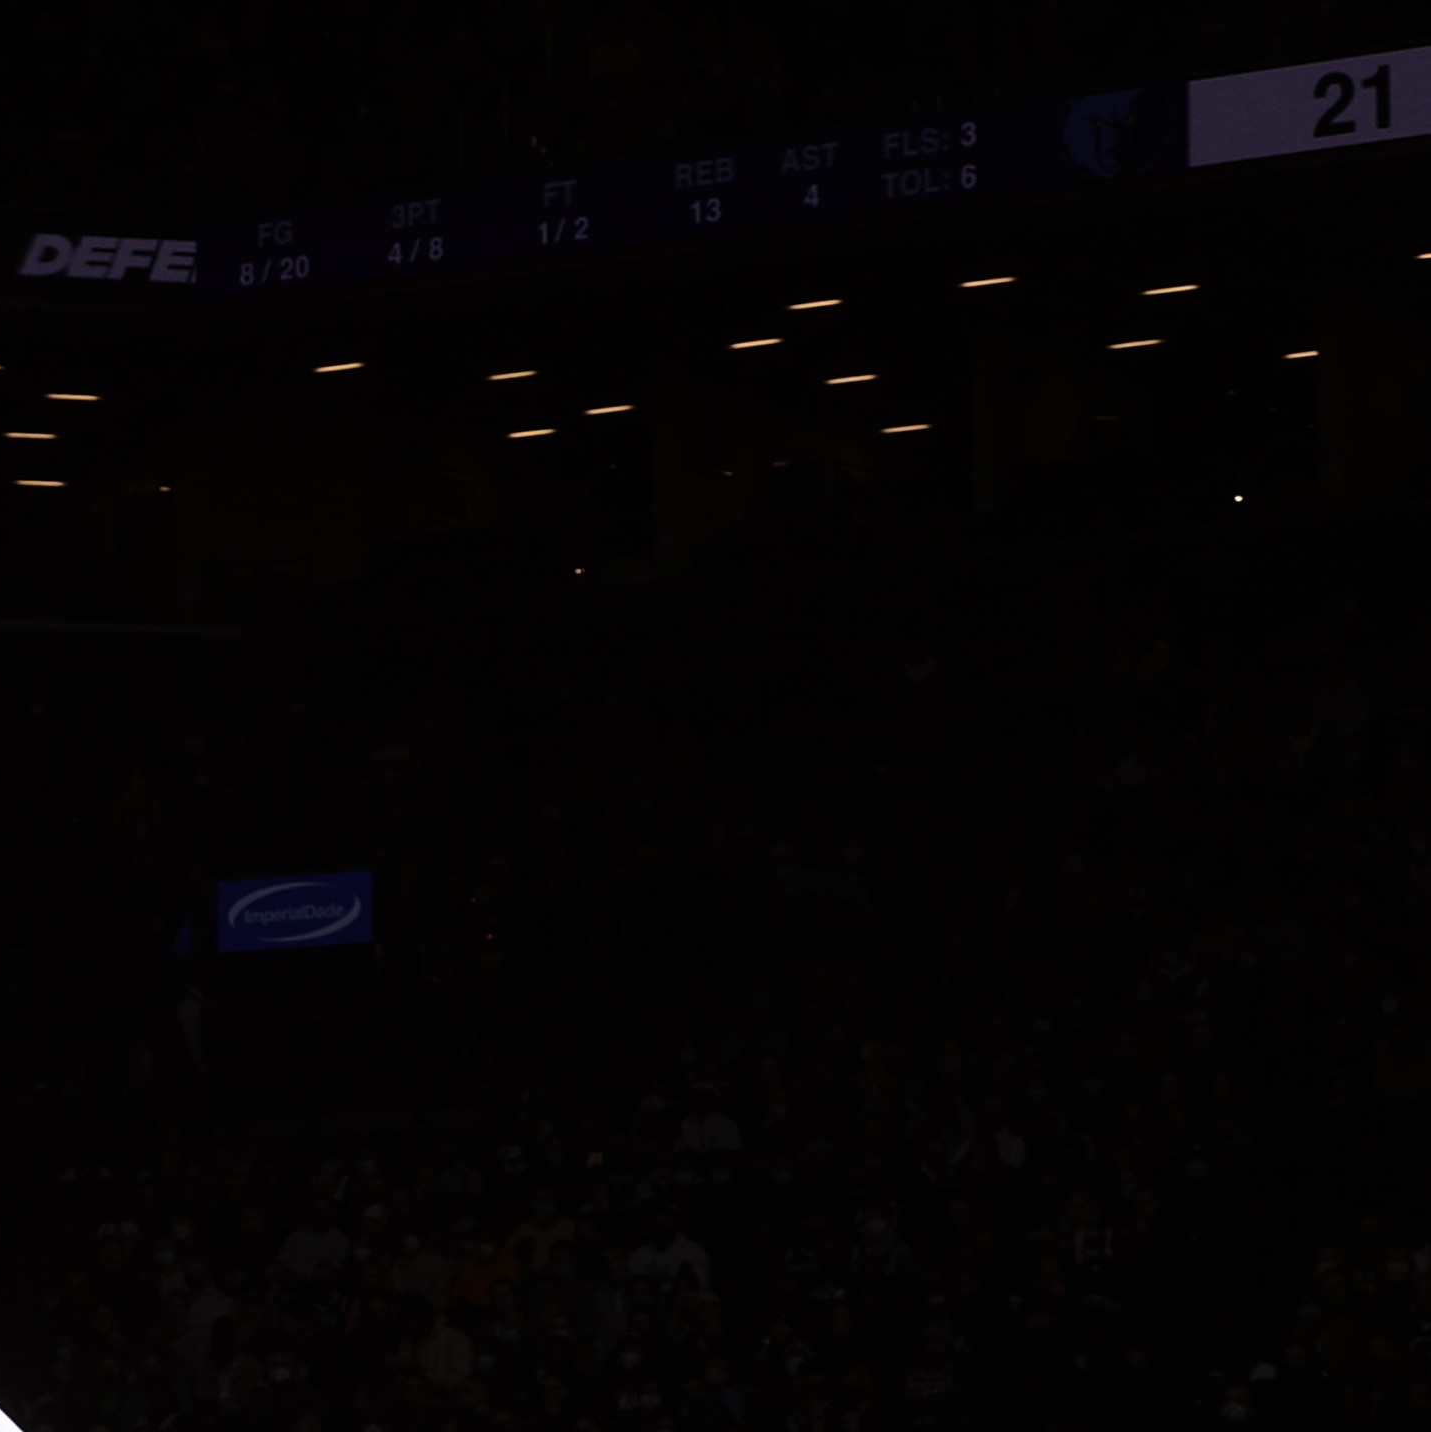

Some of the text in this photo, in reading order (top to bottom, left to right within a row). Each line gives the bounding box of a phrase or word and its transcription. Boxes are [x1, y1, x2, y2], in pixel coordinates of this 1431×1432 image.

[1312, 64, 1392, 137] 21
[883, 121, 978, 159] FLS: 3
[675, 157, 735, 189] REB
[780, 141, 839, 173] AST
[542, 179, 577, 208] FT
[803, 184, 821, 207] 4
[881, 163, 978, 198] TOL: 6
[391, 198, 442, 229] 3PT
[690, 197, 723, 224] 13
[257, 220, 294, 248] FG
[17, 233, 197, 284] DEFE
